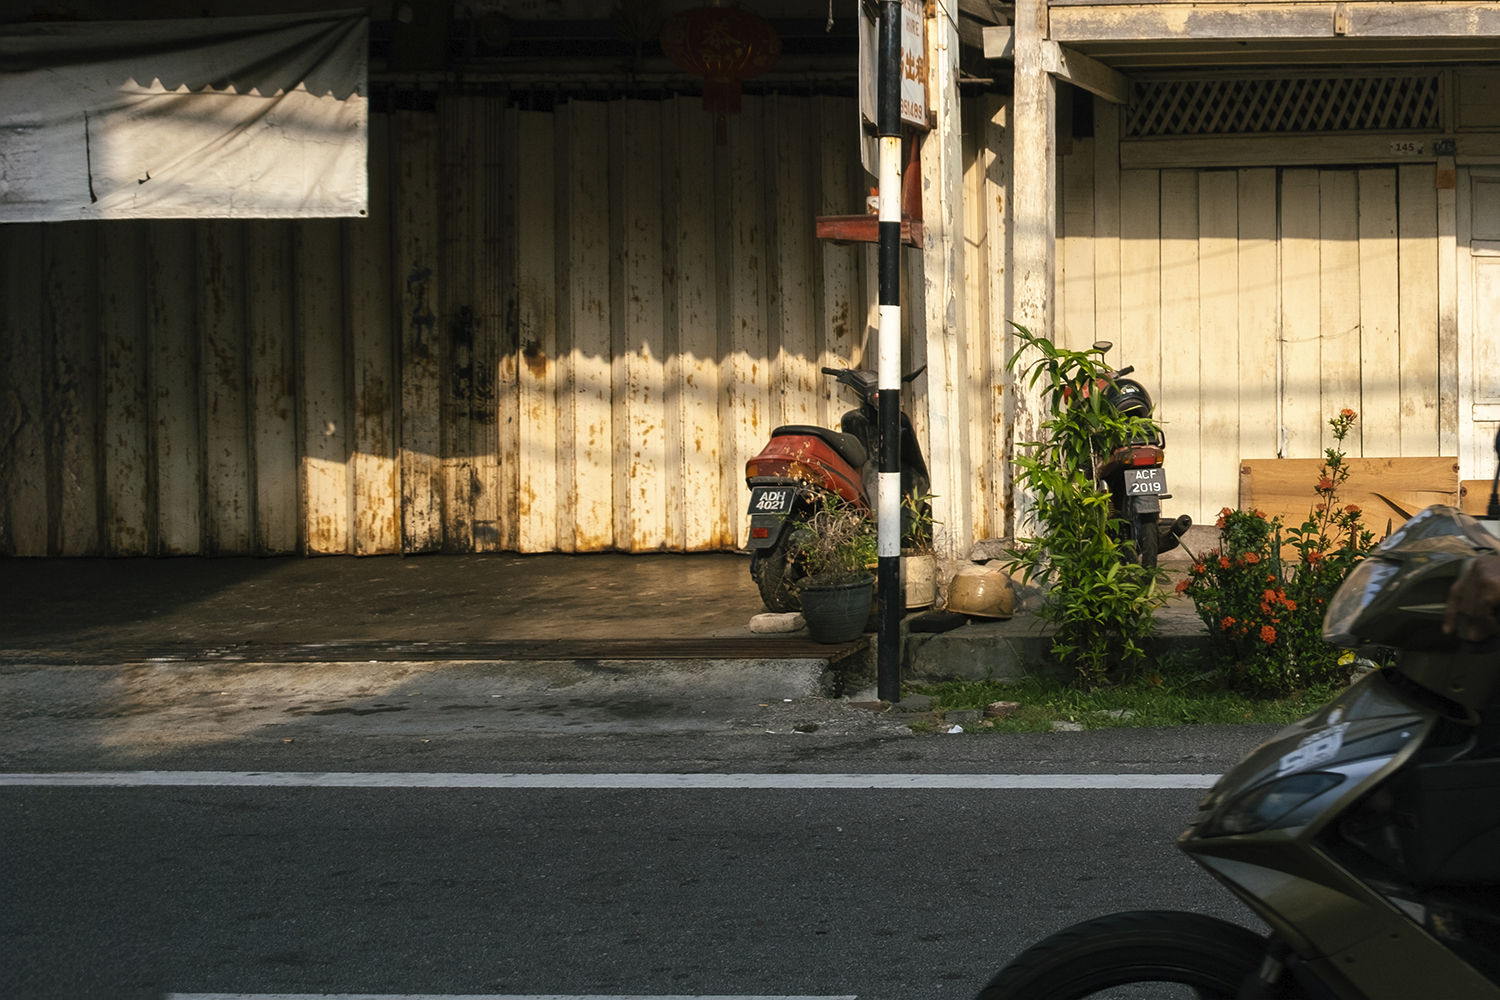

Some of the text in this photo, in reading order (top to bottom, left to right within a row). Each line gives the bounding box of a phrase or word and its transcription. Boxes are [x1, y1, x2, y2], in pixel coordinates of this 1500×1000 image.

[1395, 143, 1415, 151] 145
[1135, 469, 1157, 480] ACF
[1132, 482, 1161, 492] 2019
[759, 491, 786, 501] ADH
[756, 500, 785, 510] 4021
